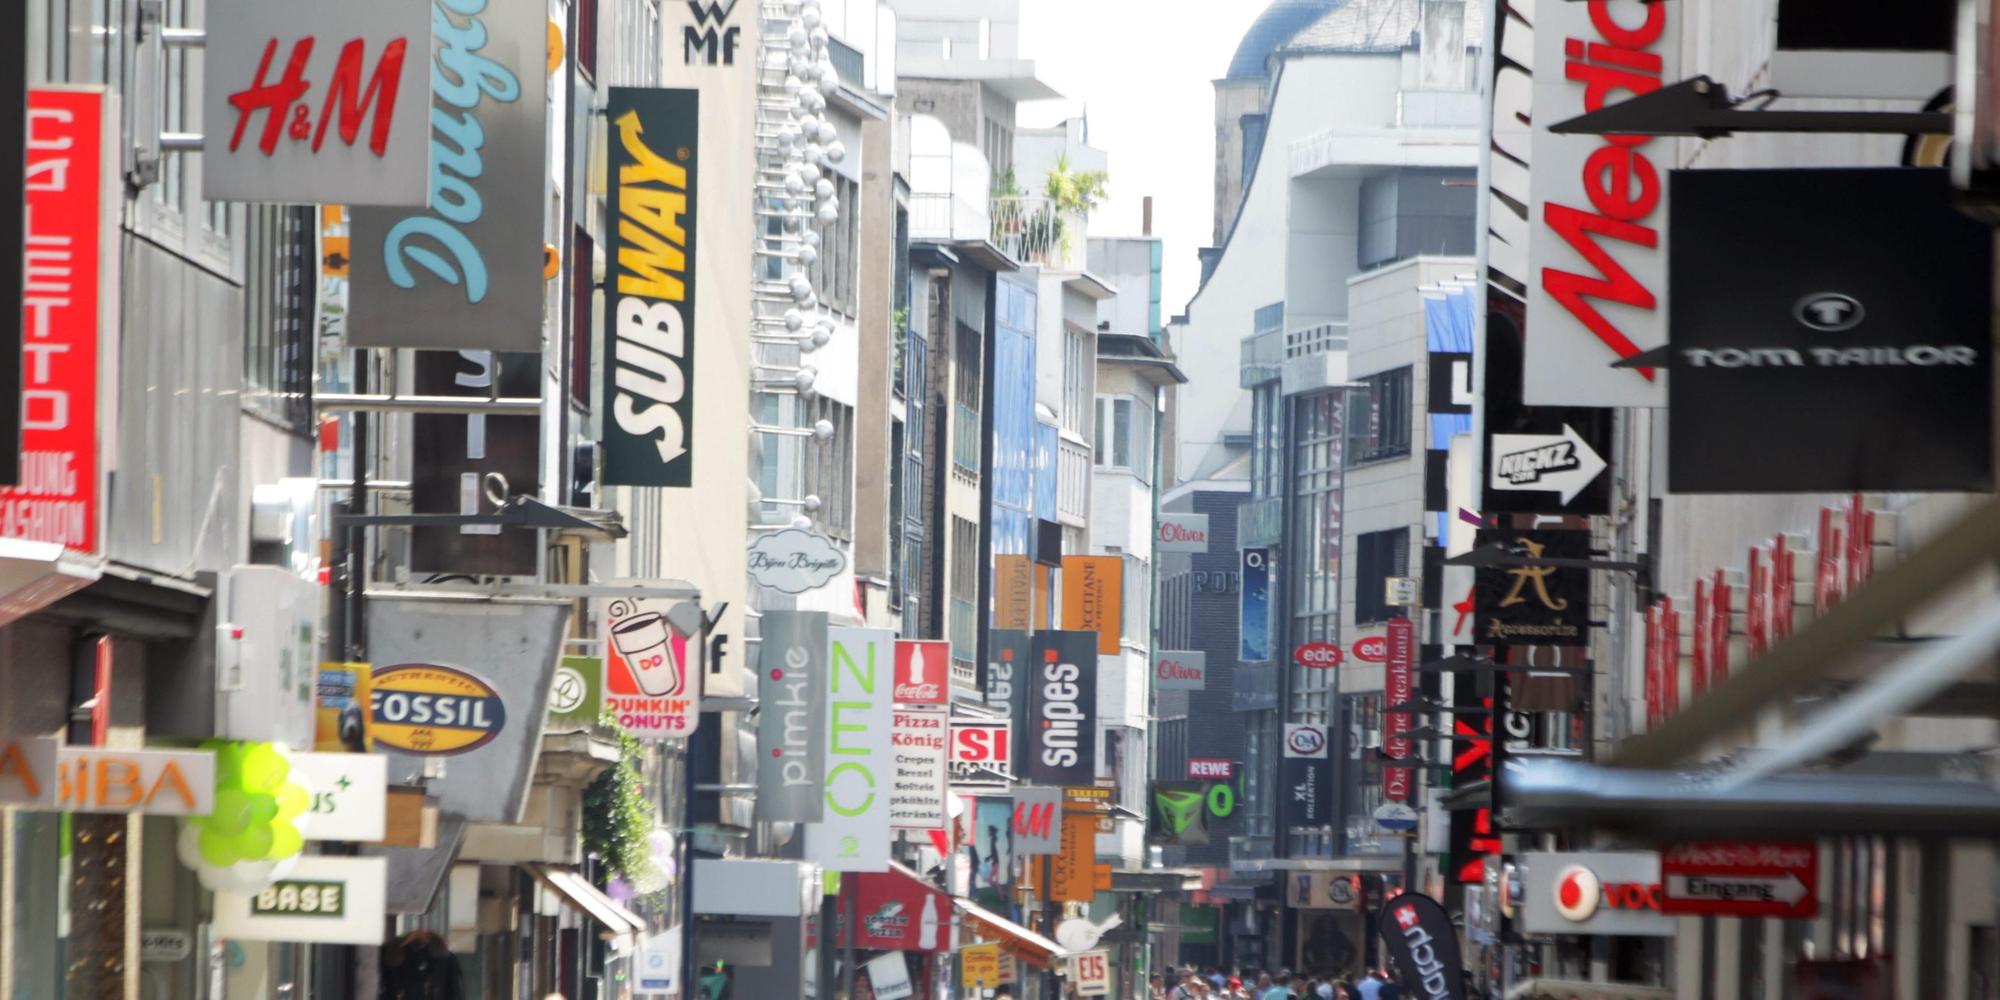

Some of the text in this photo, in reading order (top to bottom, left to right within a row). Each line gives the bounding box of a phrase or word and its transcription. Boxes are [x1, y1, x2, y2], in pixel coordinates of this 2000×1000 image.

[228, 36, 407, 158] H&M
[613, 108, 688, 464] SUBWAY
[1685, 345, 1978, 368] TOM TAILOR
[1303, 648, 1336, 663] edc
[618, 715, 687, 729] ONUTS
[770, 646, 814, 787] pimkie
[893, 714, 940, 729] Pizza
[1042, 663, 1085, 768] snipes
[891, 733, 944, 750] König
[896, 754, 935, 765] Crepes
[1190, 761, 1230, 776] REWE
[1687, 878, 1776, 901] Eingang
[1078, 955, 1105, 980] EIS
